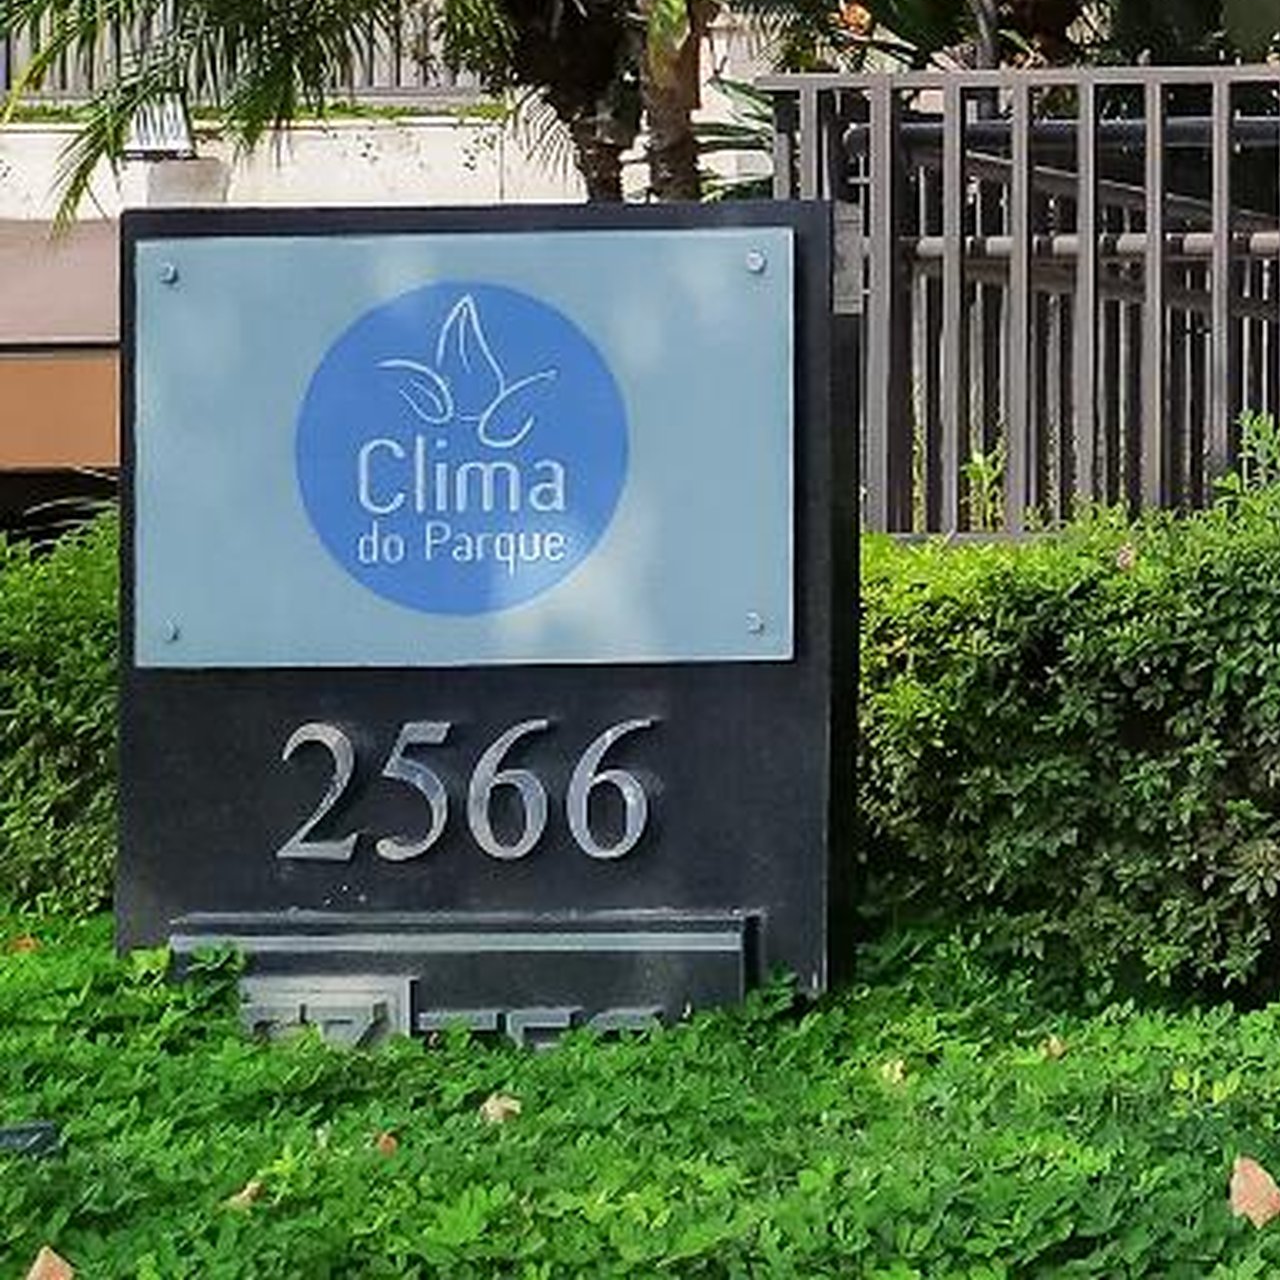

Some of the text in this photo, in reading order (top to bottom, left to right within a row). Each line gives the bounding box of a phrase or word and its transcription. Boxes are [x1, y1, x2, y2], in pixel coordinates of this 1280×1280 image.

[358, 434, 567, 514] Clima
[358, 520, 566, 578] do Parque
[276, 718, 655, 862] 2566
